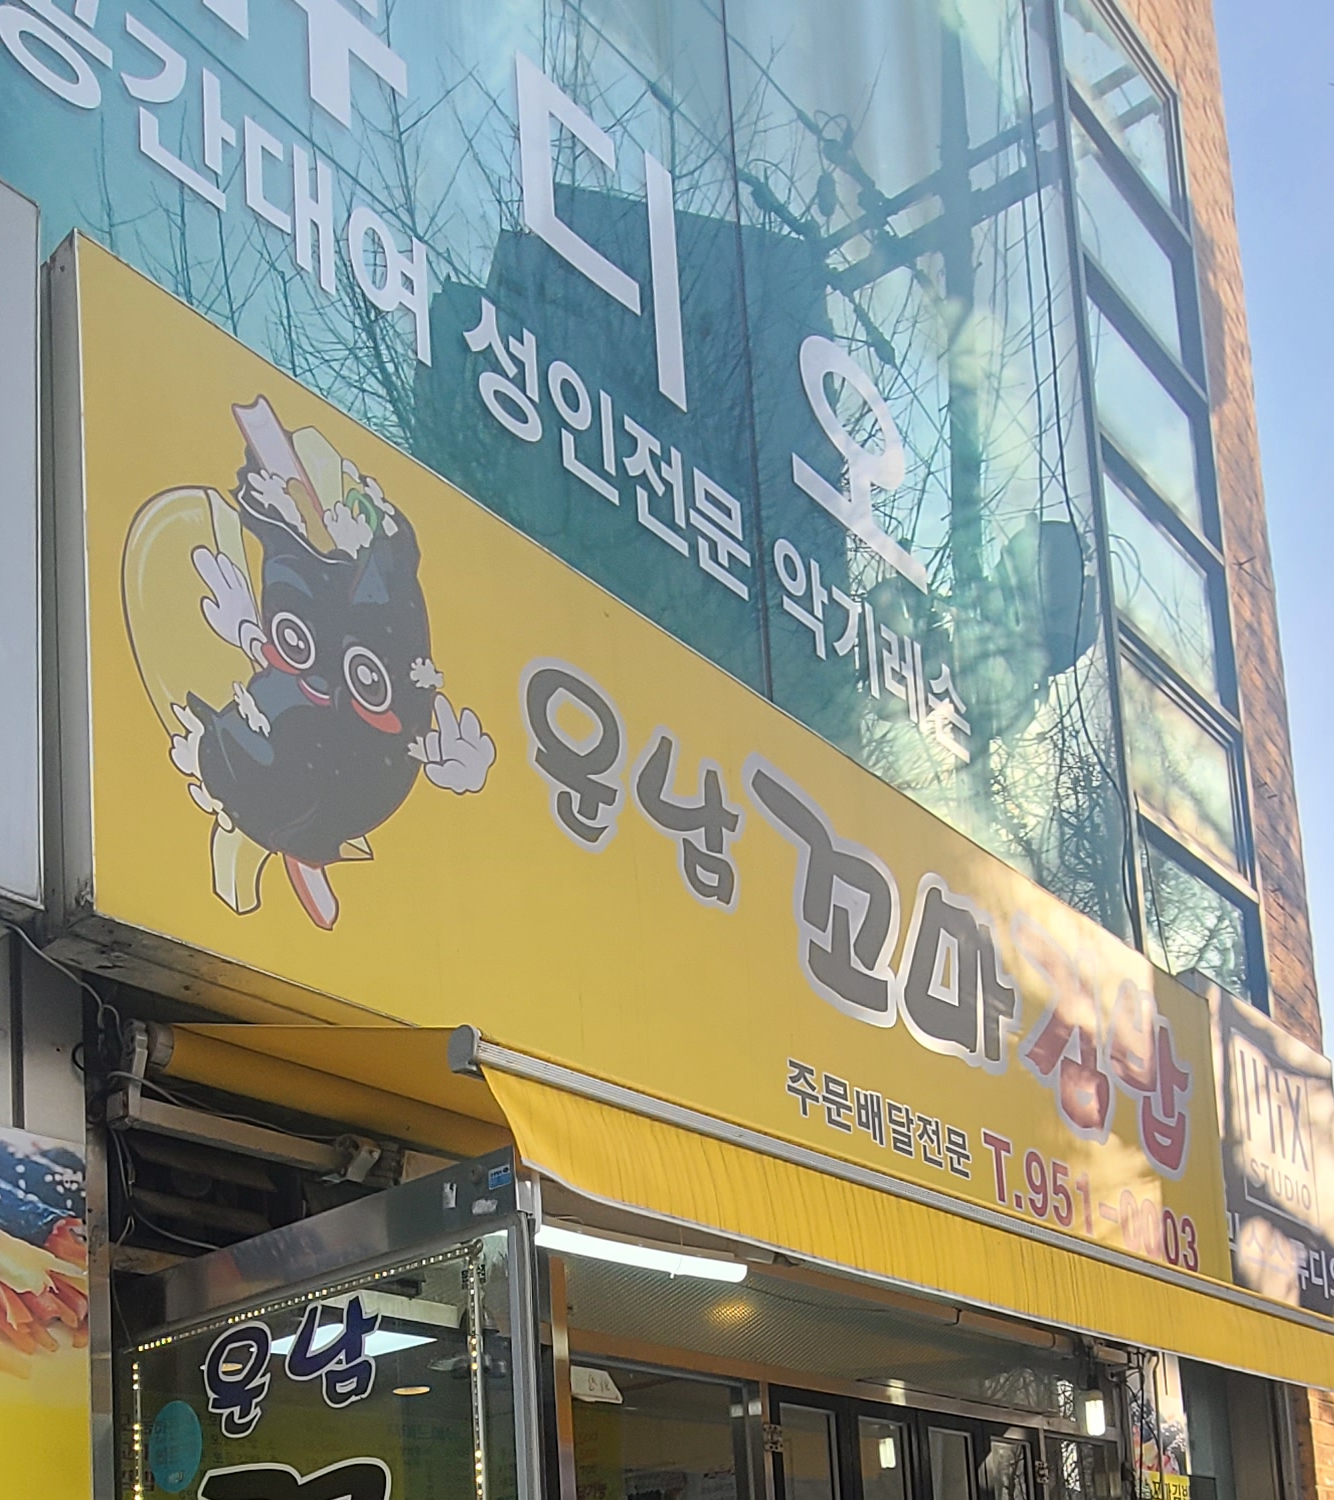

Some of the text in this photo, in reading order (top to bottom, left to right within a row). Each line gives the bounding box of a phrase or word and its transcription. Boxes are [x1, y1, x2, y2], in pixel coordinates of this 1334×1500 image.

[204, 0, 928, 593] 디오
[463, 297, 750, 602] 성인전문
[774, 538, 972, 765] 악기레슨
[519, 656, 1191, 1181] 운남 꼬마김밥
[786, 1059, 1201, 1273] 주문배달전문 T.951-0003
[1249, 1158, 1313, 1212] STUDIO
[204, 1293, 383, 1439] 운남
